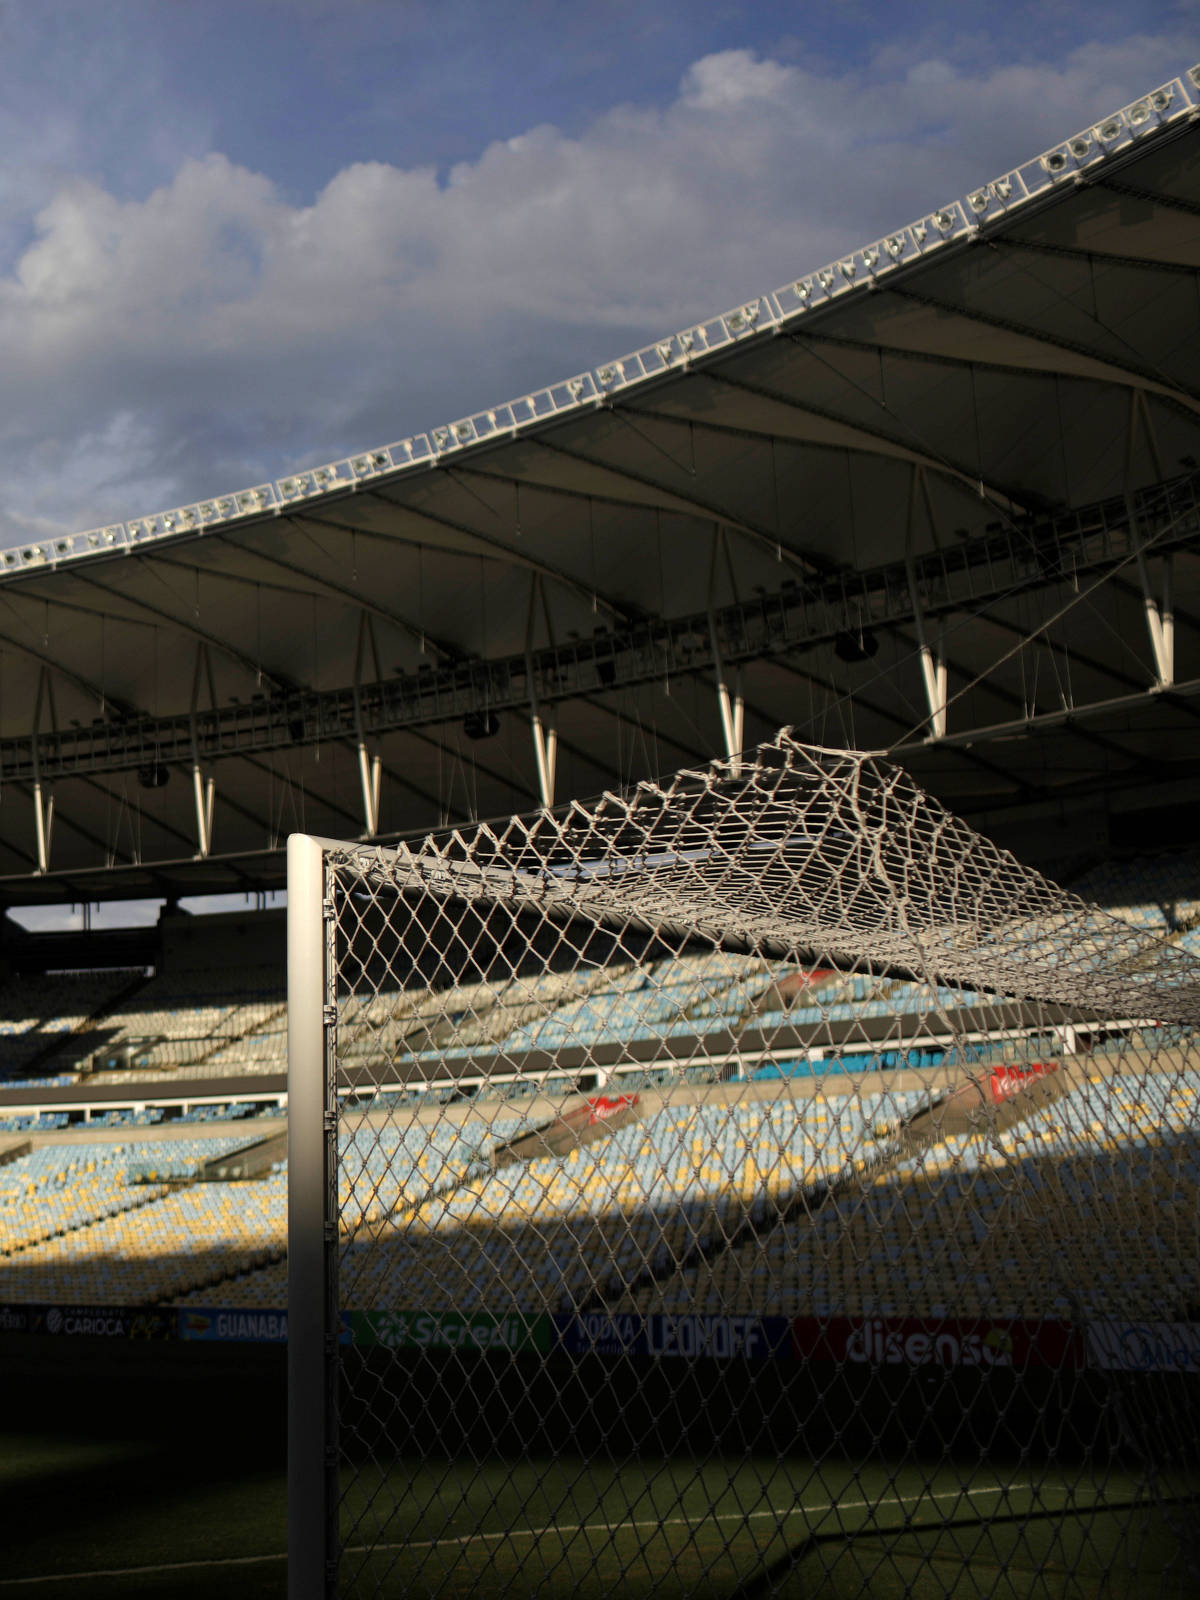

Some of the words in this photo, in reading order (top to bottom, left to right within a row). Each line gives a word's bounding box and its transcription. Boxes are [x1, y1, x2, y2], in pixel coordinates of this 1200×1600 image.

[63, 1318, 126, 1336] CARIOCA
[216, 1313, 288, 1338] GUANABA
[415, 1316, 520, 1347] Sicredi
[576, 1315, 635, 1341] VODKA
[647, 1315, 760, 1359] LEONOFF
[845, 1320, 1013, 1367] disensa
